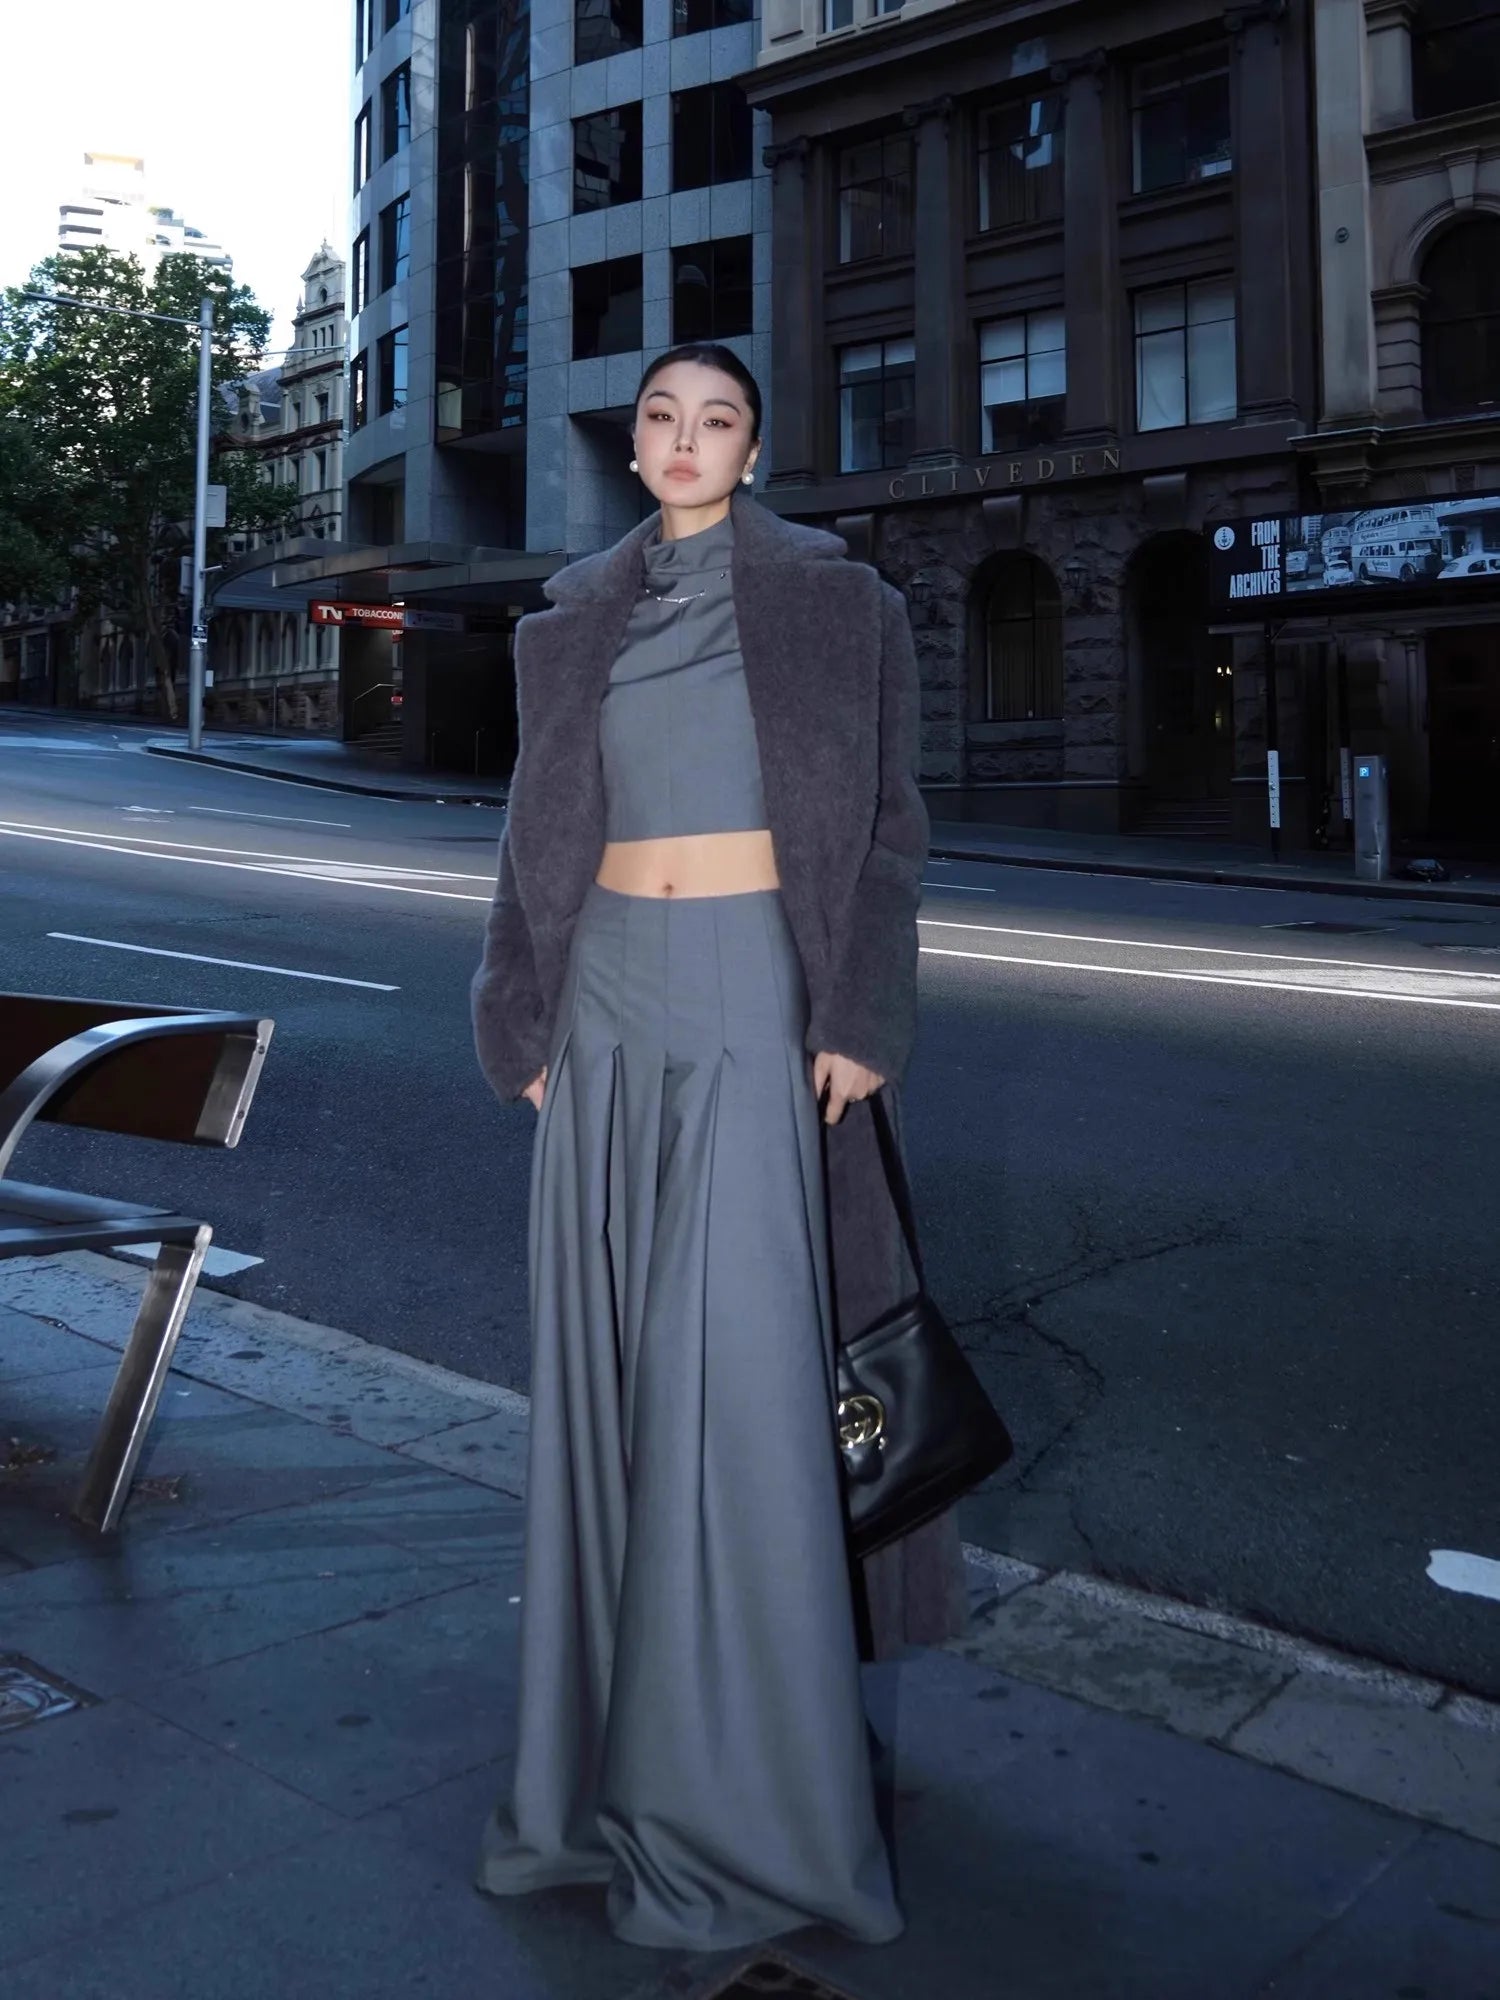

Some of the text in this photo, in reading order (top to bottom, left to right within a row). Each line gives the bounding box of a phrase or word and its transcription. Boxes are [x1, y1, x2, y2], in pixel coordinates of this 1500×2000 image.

[889, 449, 1121, 499] CLIVEDEN
[1251, 520, 1280, 546] FROM
[1261, 545, 1280, 570] THE
[1229, 569, 1280, 598] ARCHIVES
